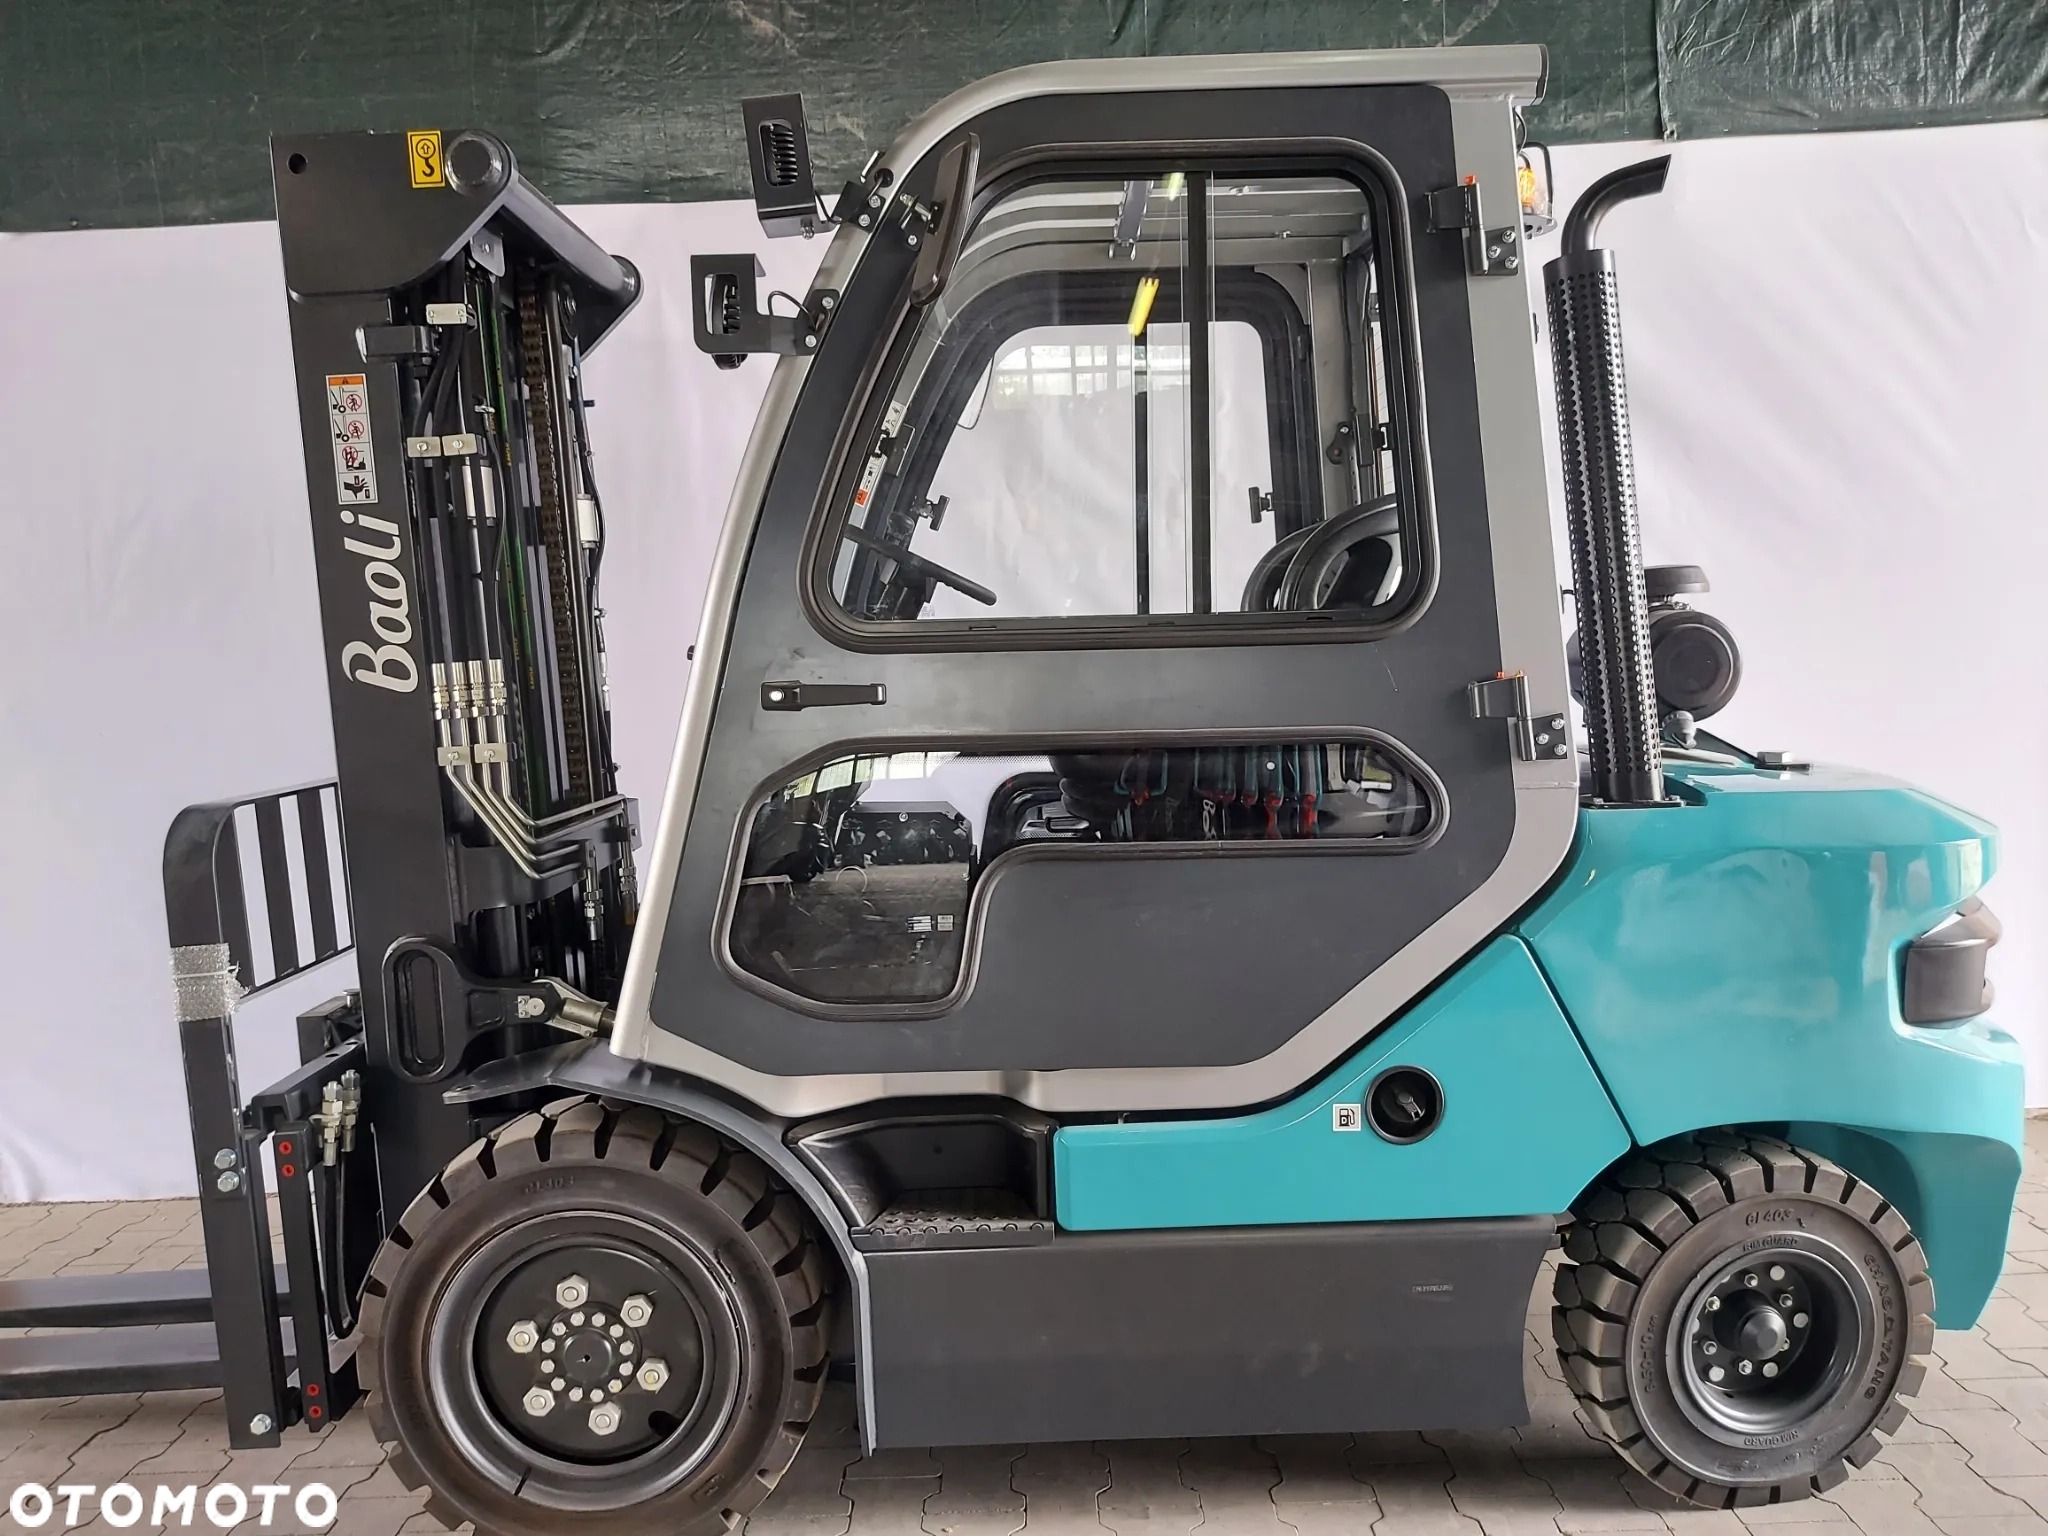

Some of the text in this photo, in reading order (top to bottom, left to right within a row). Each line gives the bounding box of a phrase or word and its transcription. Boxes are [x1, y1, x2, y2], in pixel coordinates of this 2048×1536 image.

[339, 510, 418, 693] Baoli
[1761, 1236, 1799, 1248] GUARD
[1744, 1435, 1779, 1446] GUARD
